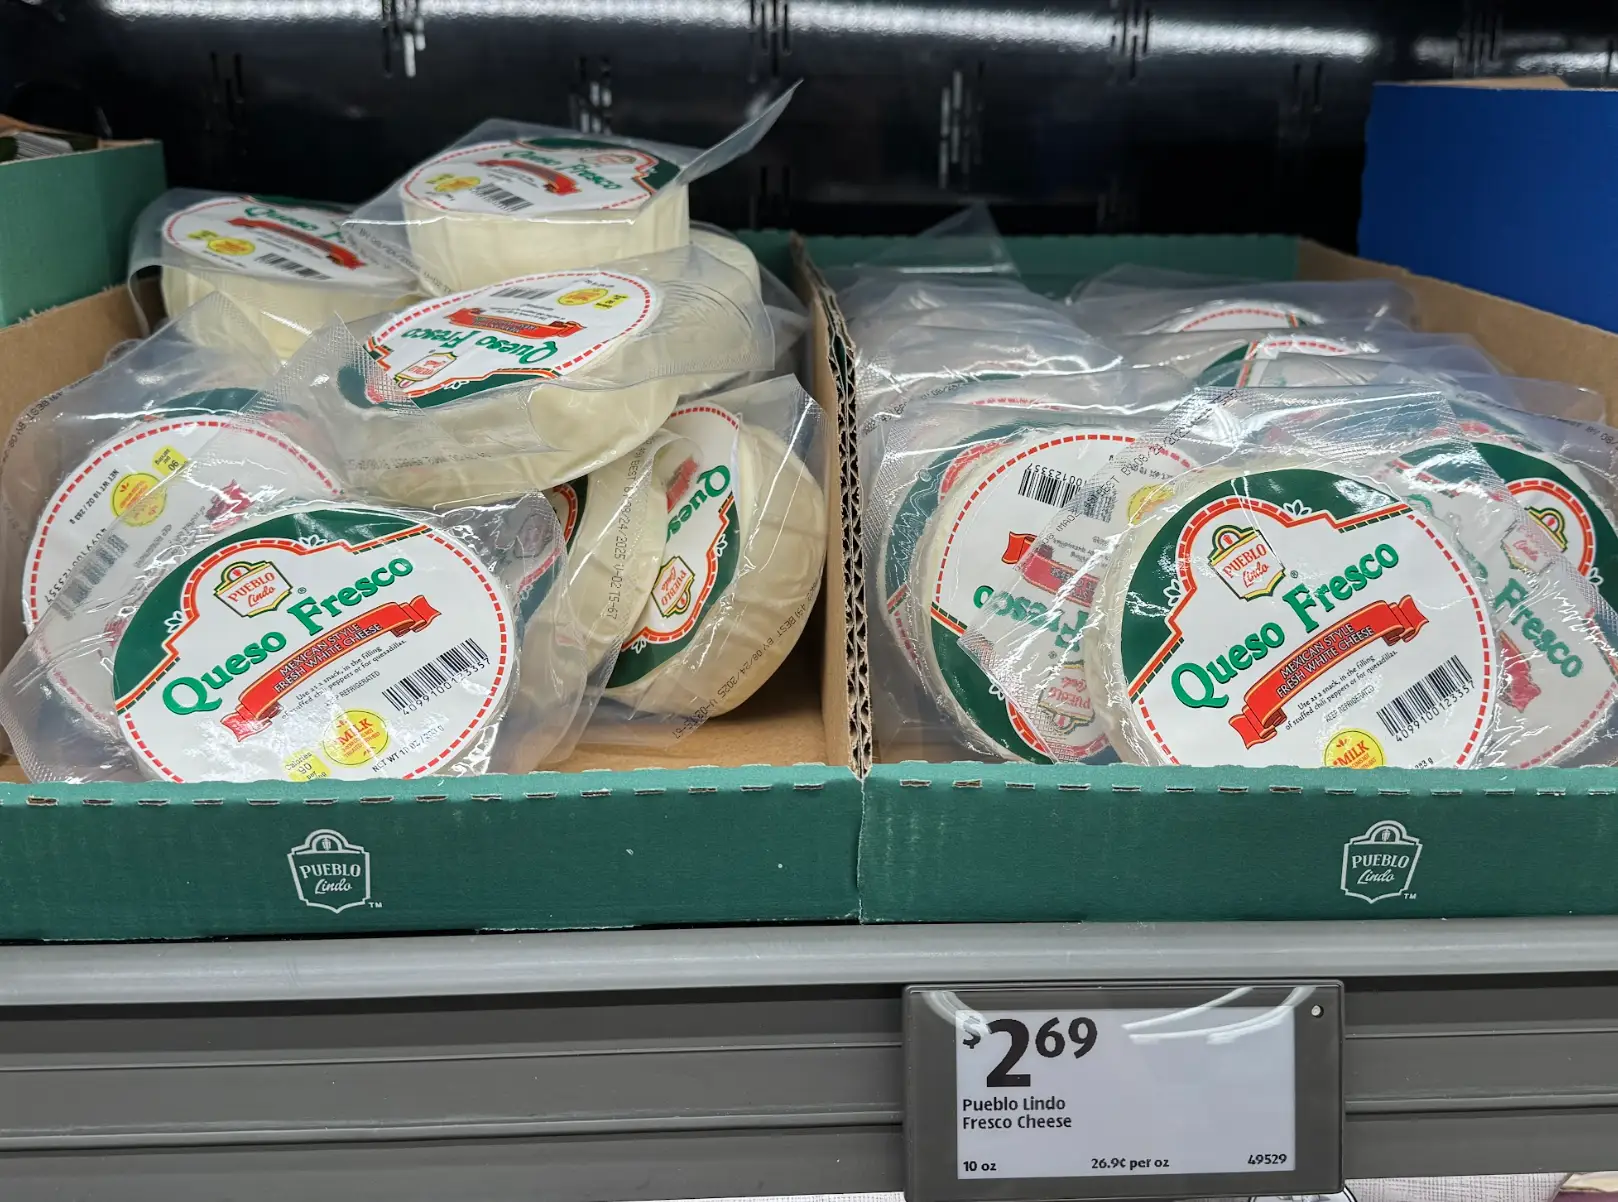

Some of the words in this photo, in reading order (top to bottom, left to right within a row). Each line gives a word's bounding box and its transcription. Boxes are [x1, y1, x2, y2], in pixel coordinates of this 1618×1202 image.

[401, 328, 482, 349] Fresco
[475, 335, 559, 365] Queso
[665, 464, 731, 544] Ques
[1223, 543, 1267, 578] PUEBLO
[1243, 561, 1269, 588] Lindo
[228, 572, 275, 603] PUEBLO
[248, 586, 276, 607] Lindo
[660, 570, 687, 606] PUEBLO
[162, 631, 287, 716] Queso
[286, 555, 415, 637] Fresco
[776, 615, 797, 638] BEST
[1170, 621, 1286, 709] Queso
[1282, 543, 1400, 634] Fresco
[274, 667, 307, 693] FRESH
[304, 643, 342, 669] WHITE
[343, 623, 384, 647] CHEESE
[280, 641, 329, 677] MEXICAN
[327, 623, 361, 645] STYLE
[762, 637, 774, 652] BY
[1280, 641, 1323, 680] MEXICAN
[1324, 624, 1355, 647] STYLE
[296, 689, 310, 701] Use
[343, 664, 352, 672] in
[350, 658, 361, 668] the
[361, 646, 383, 660] filling
[328, 672, 354, 690] peppers
[361, 659, 372, 670] for
[717, 649, 763, 699] 08/24/2025
[1276, 671, 1307, 699] FRESH
[1303, 647, 1340, 674] WHITE
[1338, 625, 1376, 651] CHEESE
[339, 670, 381, 699] REFRIGERATED
[402, 656, 491, 716] 4099100123357
[1285, 721, 1292, 731] of
[1314, 698, 1327, 711] chili
[1326, 683, 1350, 703] peppers
[1356, 671, 1367, 682] for
[1366, 650, 1398, 675] quesadillas.
[1297, 699, 1311, 711] Use
[1322, 679, 1341, 695] snack,
[1339, 674, 1347, 682] in
[1347, 667, 1357, 678] the
[1356, 654, 1376, 670] filling
[1395, 680, 1475, 741] 4099100123357
[387, 752, 400, 764] WT
[299, 863, 361, 879] PUEBLO
[1351, 853, 1410, 869] PUEBLO
[315, 878, 353, 894] Lindo
[1357, 869, 1395, 884] Lindo
[963, 1097, 1019, 1112] Pueblo
[1023, 1096, 1066, 1111] Lindo
[963, 1115, 1012, 1130] Fresco
[1017, 1115, 1072, 1128] Cheese
[963, 1160, 977, 1172] 10
[981, 1162, 997, 1172] oz
[1091, 1157, 1126, 1170] 26.9¢
[1129, 1157, 1152, 1171] per
[1154, 1157, 1170, 1168] oz
[1247, 1153, 1288, 1166] 49529
